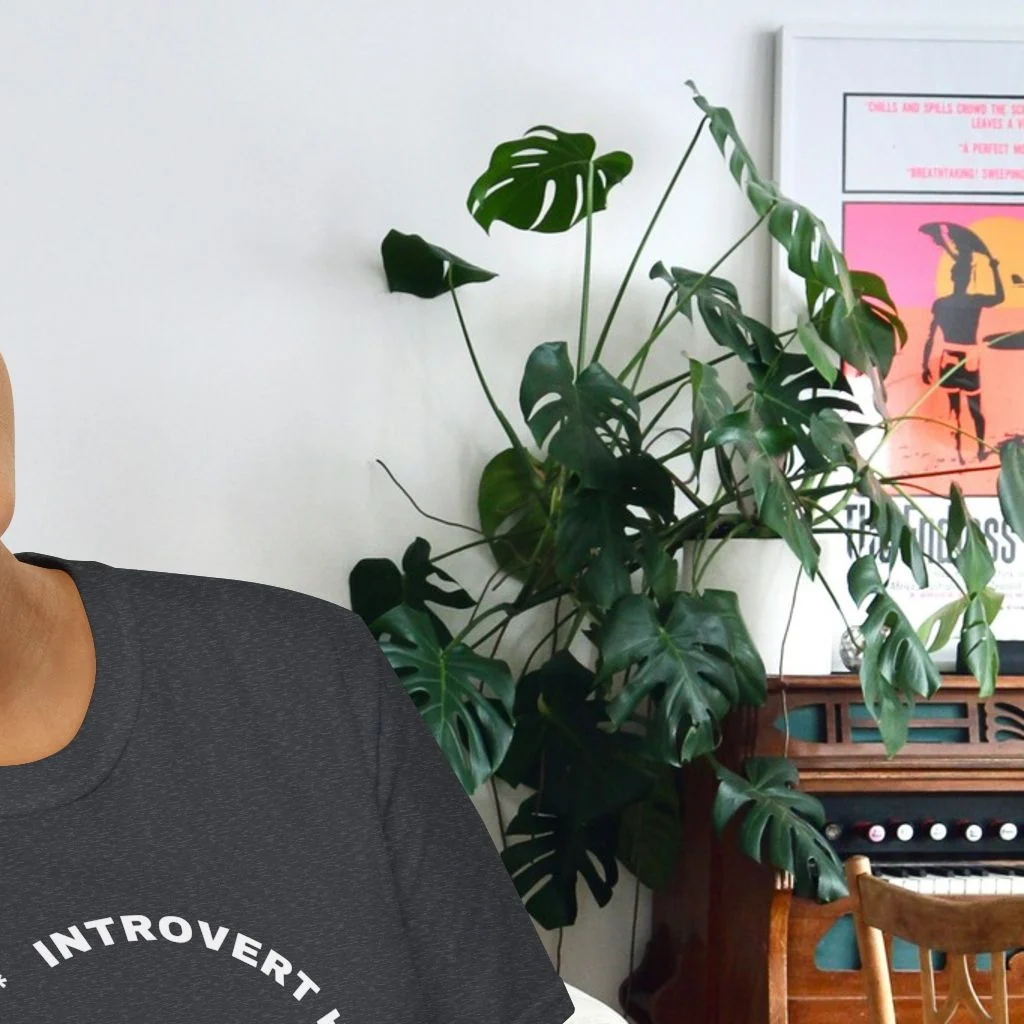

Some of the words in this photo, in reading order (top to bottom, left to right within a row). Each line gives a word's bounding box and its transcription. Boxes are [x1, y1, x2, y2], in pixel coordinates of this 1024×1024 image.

[902, 102, 919, 113] AND
[924, 102, 953, 114] SPILLS
[992, 103, 1006, 115] THE
[972, 117, 1003, 129] LEAVES
[1008, 118, 1013, 129] A
[973, 143, 1009, 155] PERFECT
[32, 914, 321, 1002] INTROVERT
